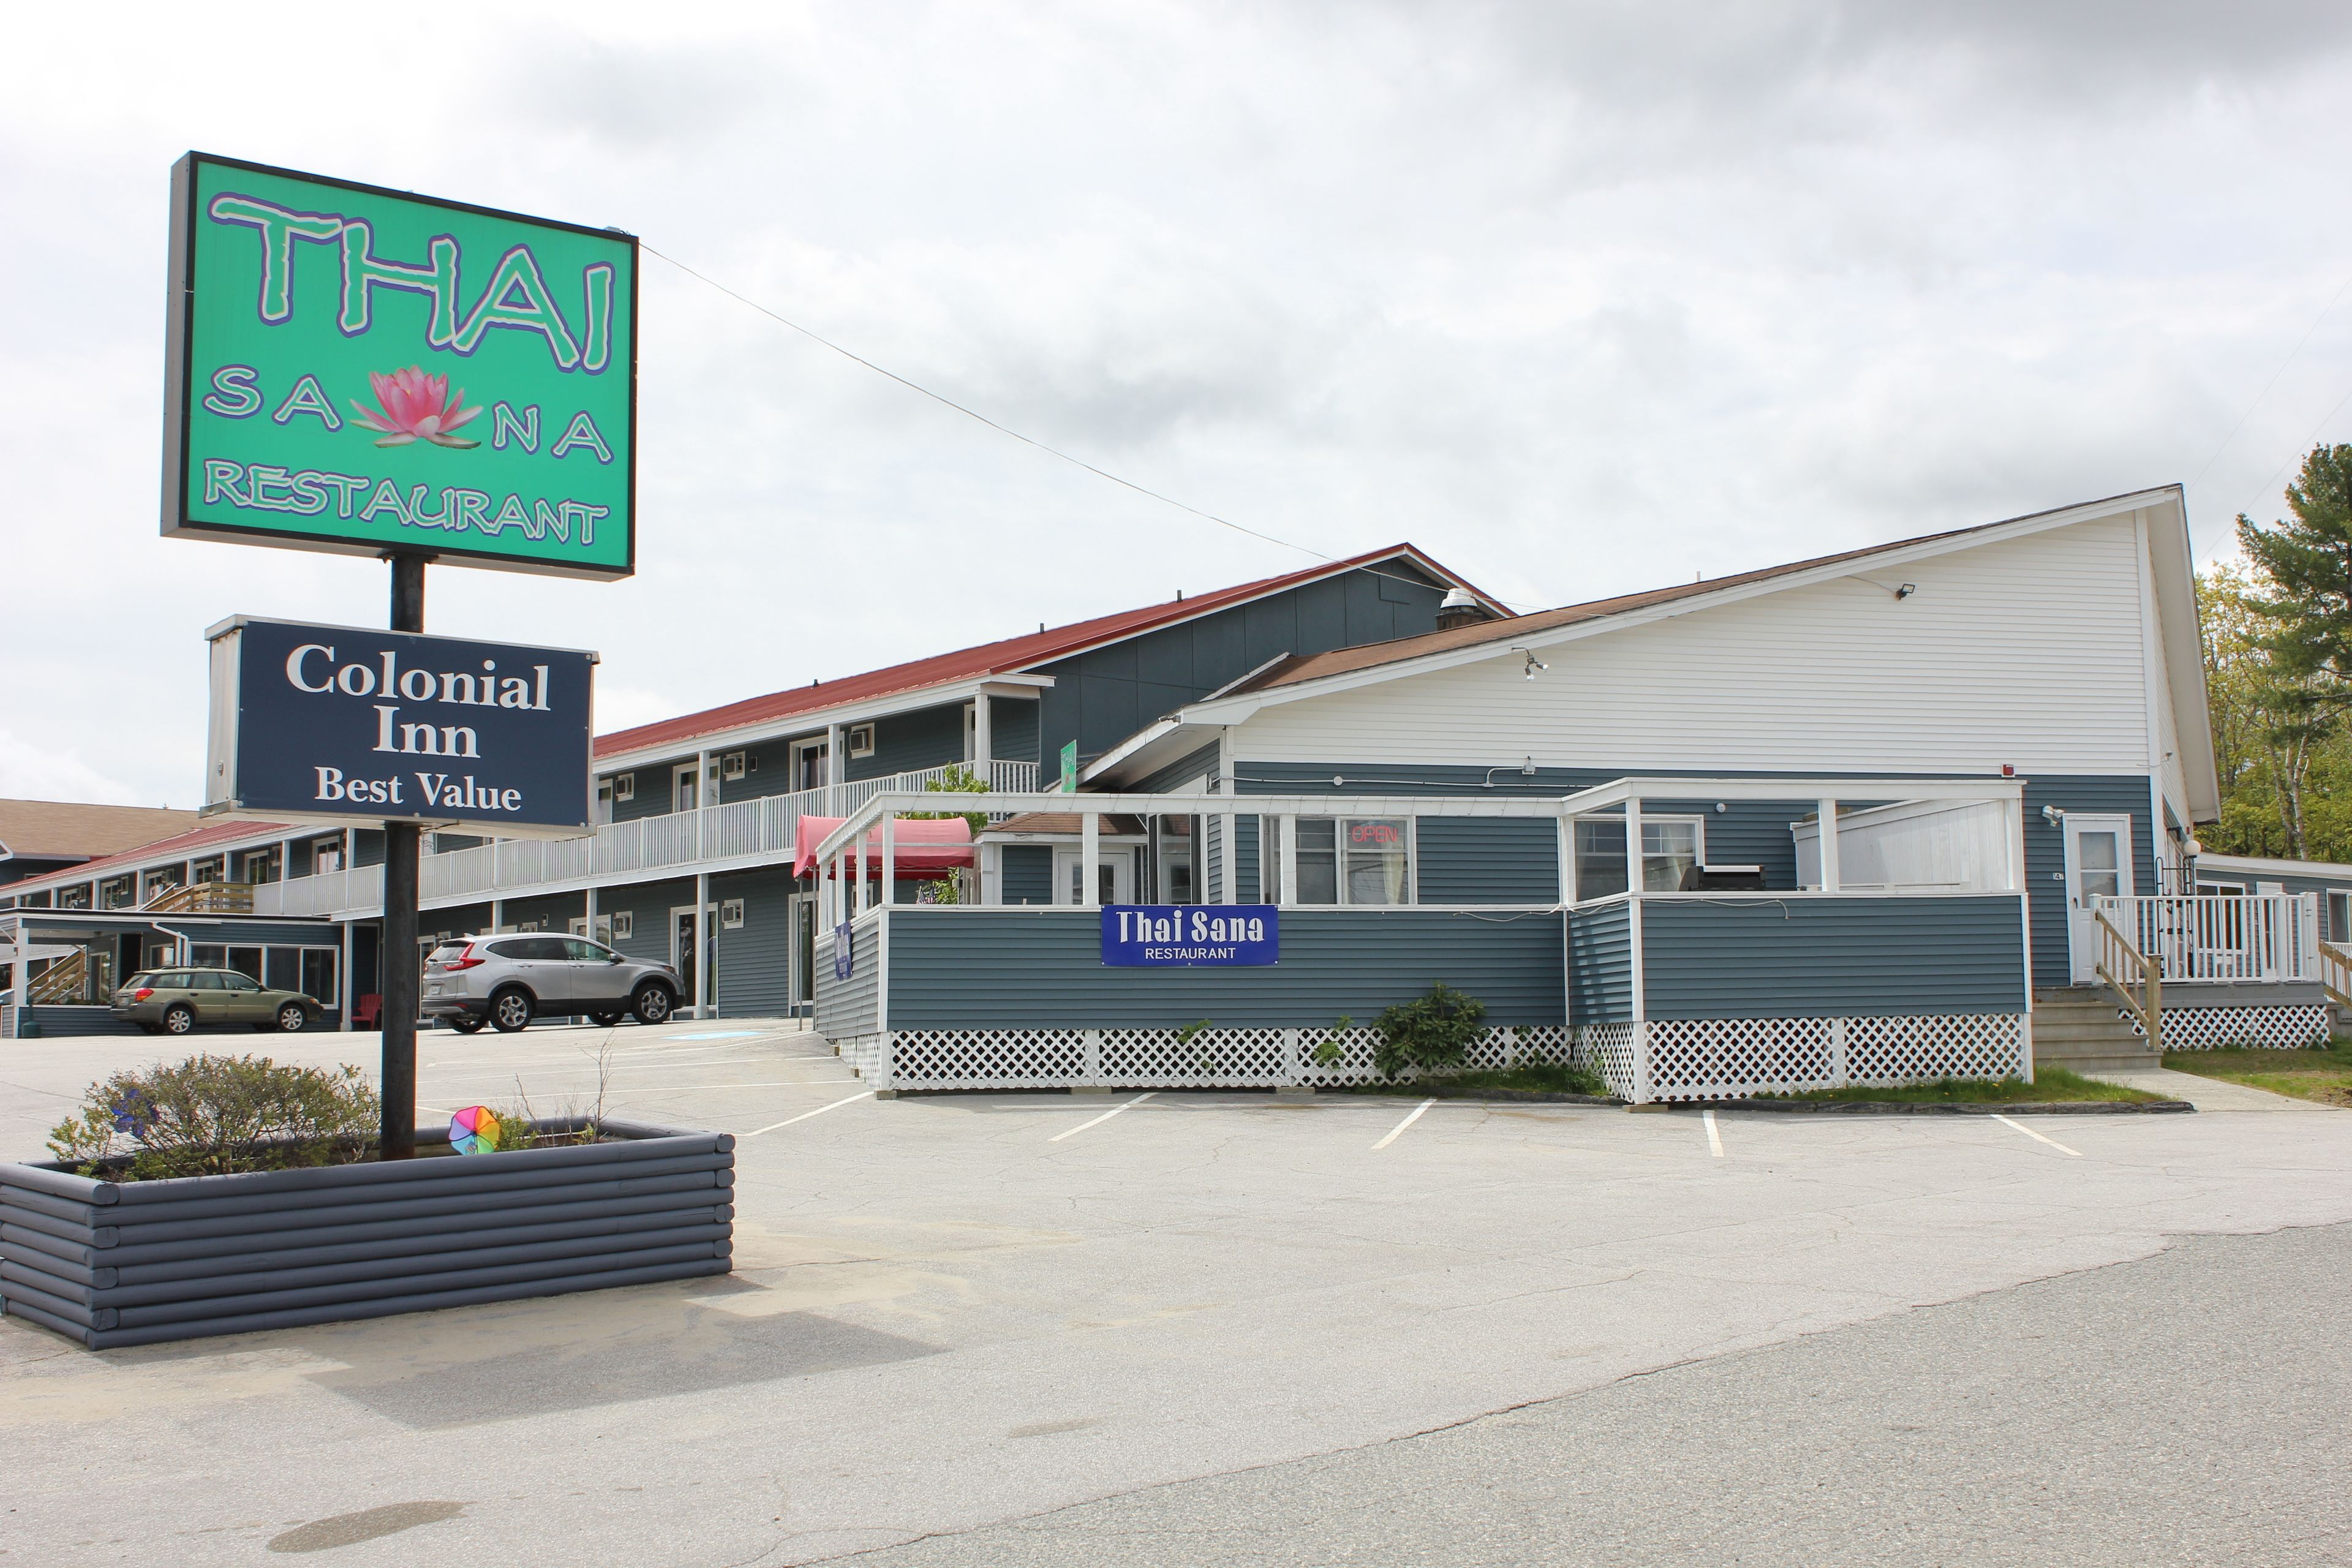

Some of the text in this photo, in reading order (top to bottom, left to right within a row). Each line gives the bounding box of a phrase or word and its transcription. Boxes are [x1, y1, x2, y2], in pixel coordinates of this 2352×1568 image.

[208, 191, 616, 374] THAI
[203, 458, 609, 545] RESTAURANT
[286, 644, 551, 712] Colonial
[372, 705, 481, 758] Inn
[315, 767, 522, 812] Best Value
[1352, 826, 1398, 842] OPEN
[1115, 910, 1265, 943] Thai Sana
[1145, 948, 1236, 959] RESTAURANT
